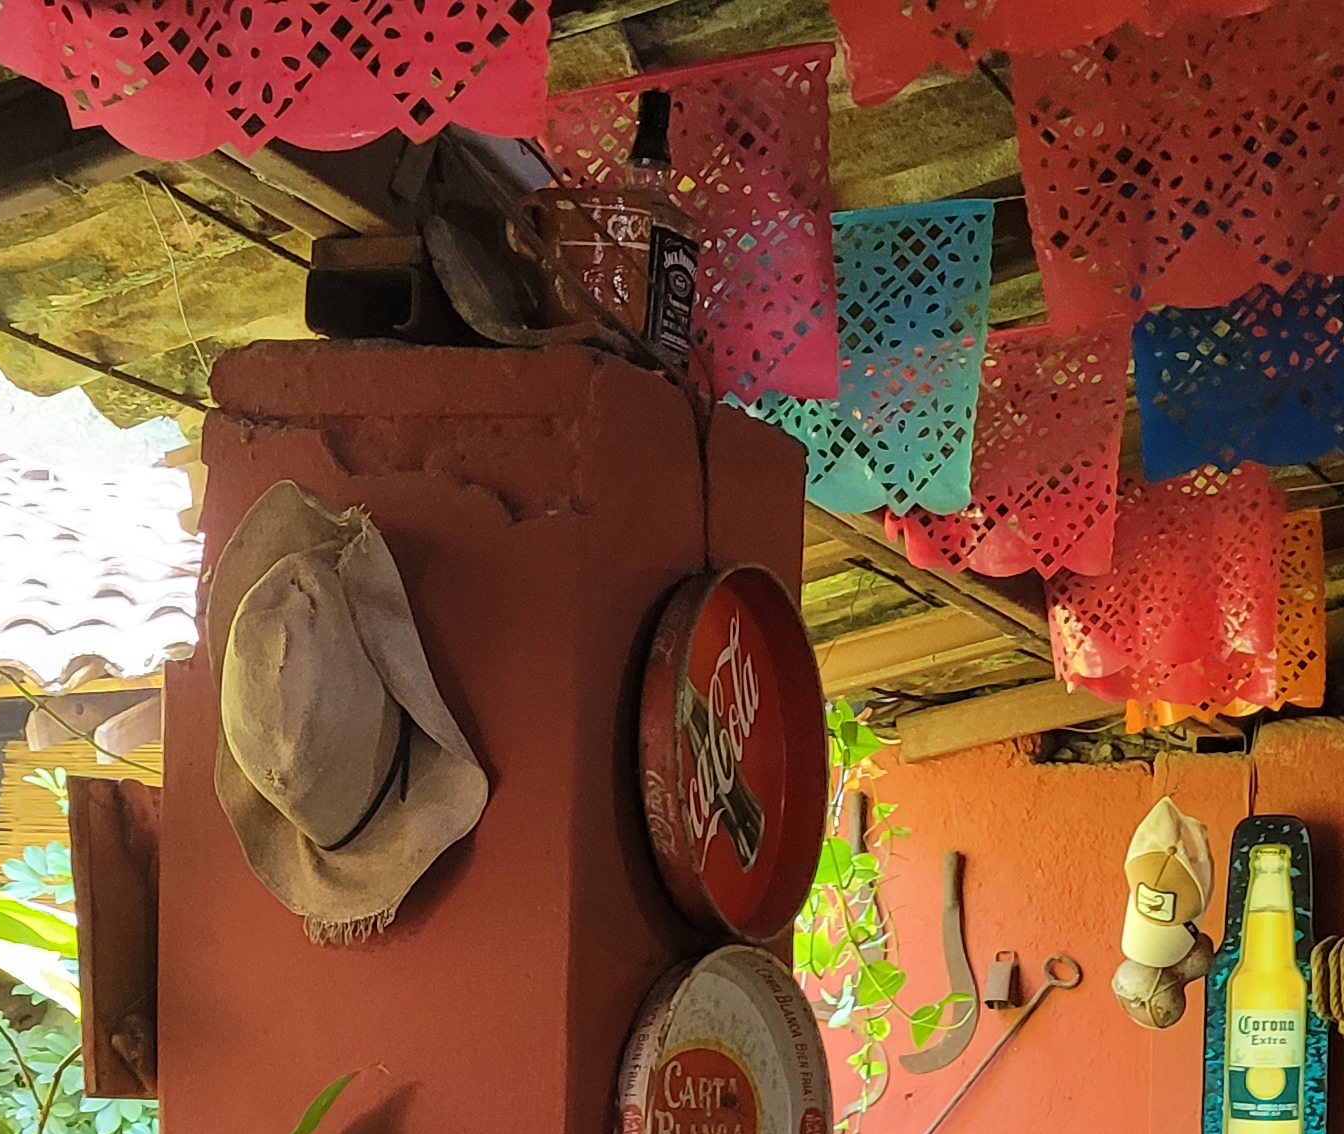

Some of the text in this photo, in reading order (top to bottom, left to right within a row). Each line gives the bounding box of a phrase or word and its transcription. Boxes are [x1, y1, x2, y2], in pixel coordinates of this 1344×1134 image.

[774, 994, 803, 1039] BLANCA
[794, 1042, 809, 1068] BIEN
[1238, 1015, 1296, 1035] Corona
[1251, 1033, 1288, 1046] Extra
[663, 1060, 738, 1117] CARTA
